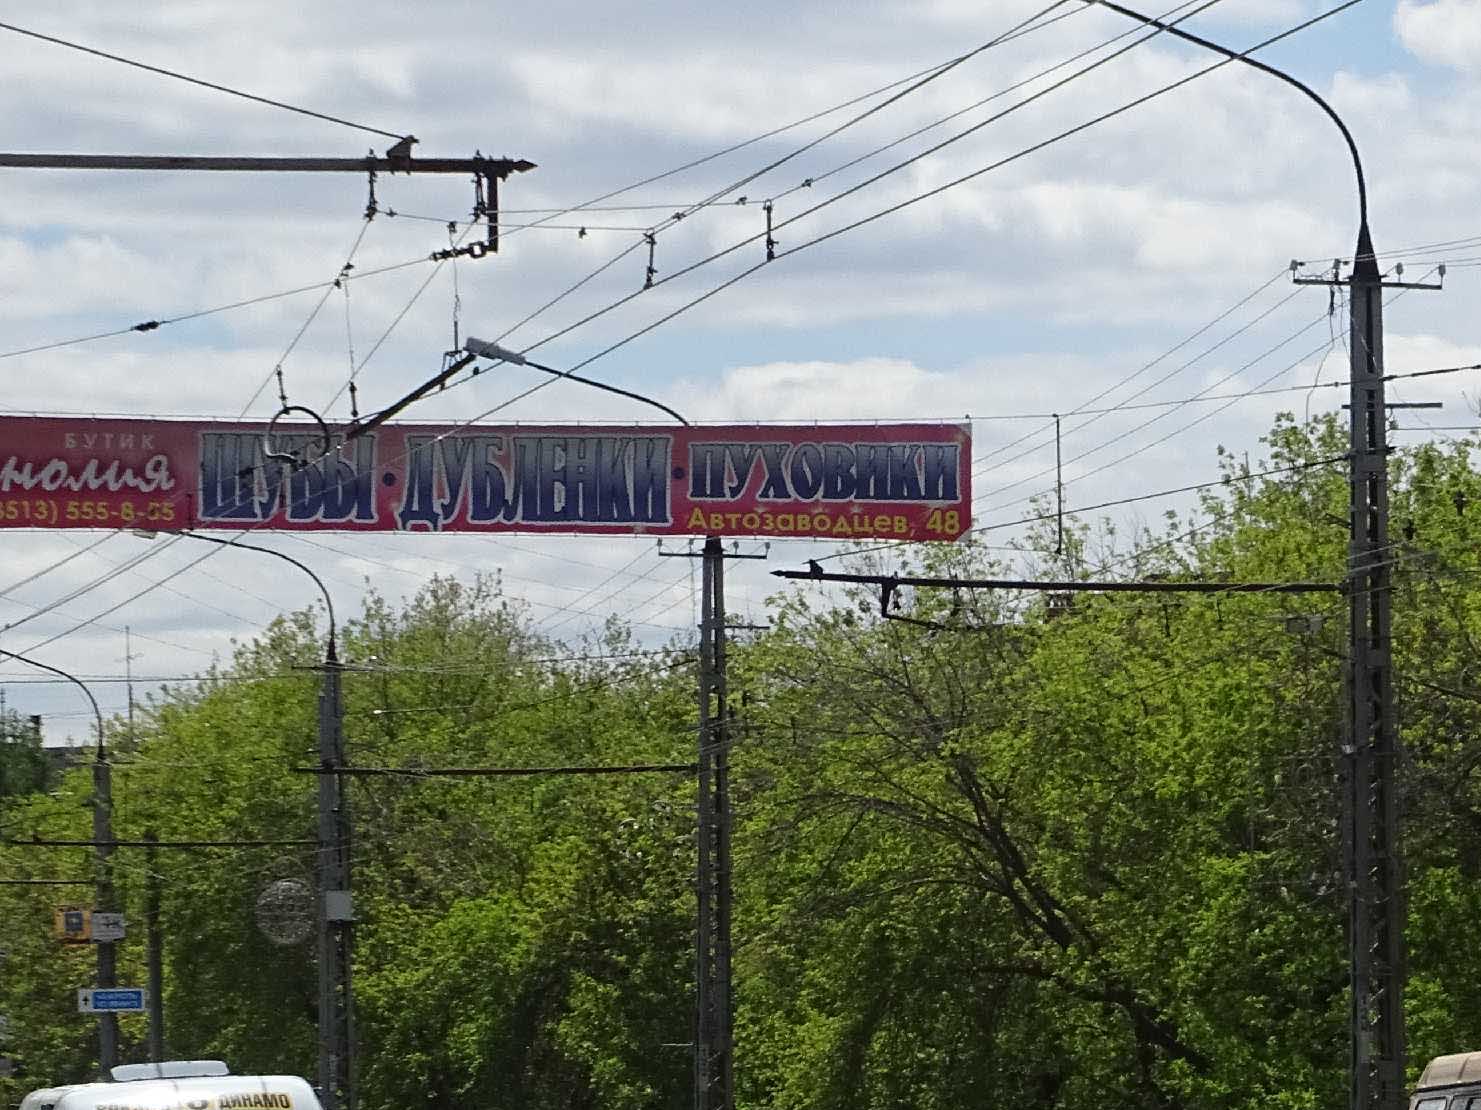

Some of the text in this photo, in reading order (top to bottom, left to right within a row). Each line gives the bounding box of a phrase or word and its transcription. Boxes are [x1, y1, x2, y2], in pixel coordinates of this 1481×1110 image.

[65, 433, 155, 449] БУТИК
[199, 431, 961, 531] ШУБЫ ДУБЛЕНКИ ПУХОВИКИ
[688, 507, 960, 537] Автозаводцев, 48
[219, 1094, 291, 1110] ДИНАМО
